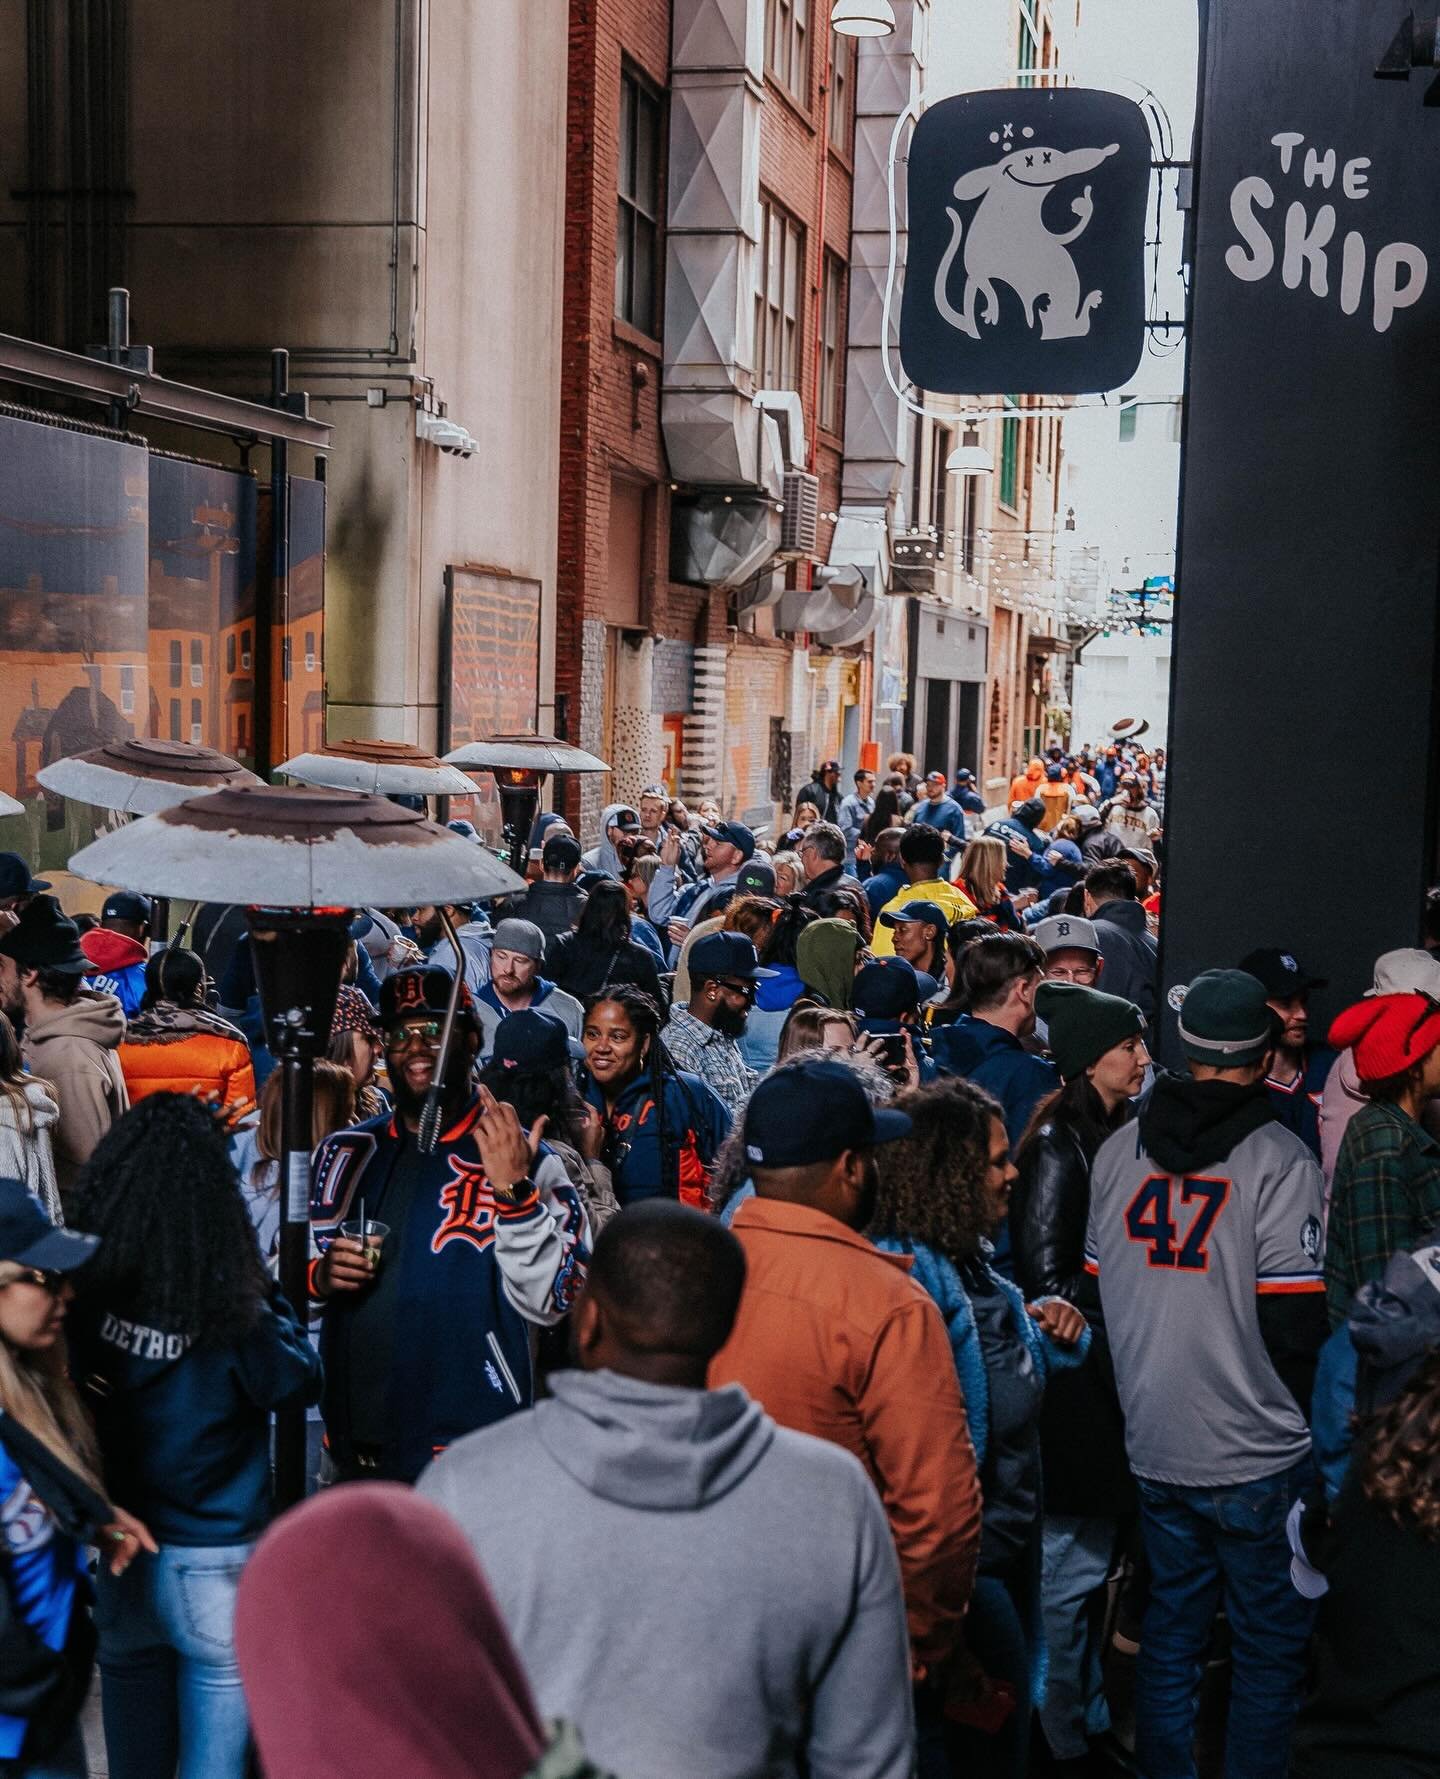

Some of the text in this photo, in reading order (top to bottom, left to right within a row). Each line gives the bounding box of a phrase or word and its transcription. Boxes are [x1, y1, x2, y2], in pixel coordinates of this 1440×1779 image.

[1271, 132, 1371, 199] THE
[1225, 175, 1428, 333] SKIP
[1123, 1173, 1232, 1274] 47
[101, 1311, 191, 1360] DETRO
